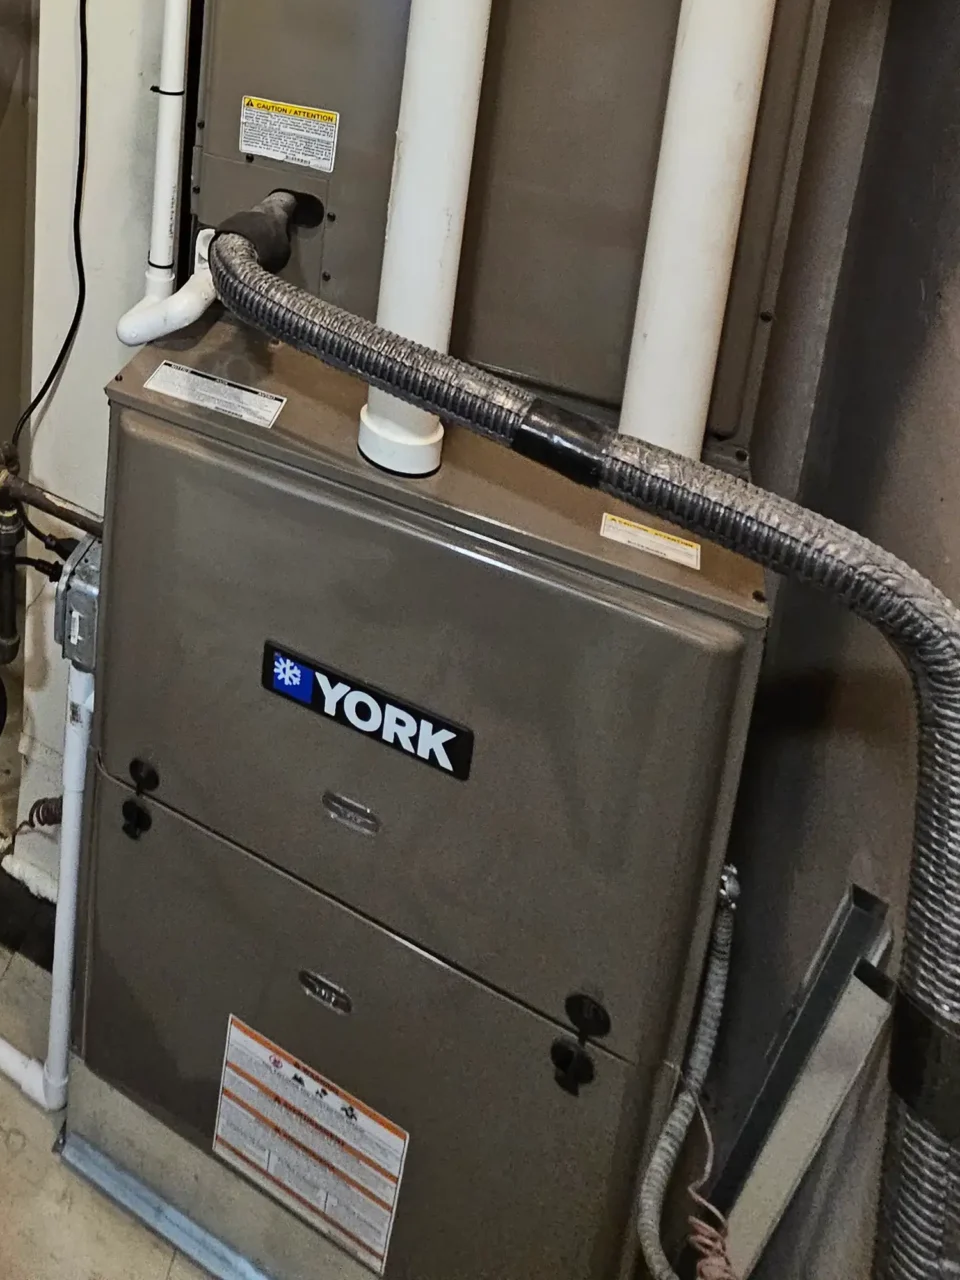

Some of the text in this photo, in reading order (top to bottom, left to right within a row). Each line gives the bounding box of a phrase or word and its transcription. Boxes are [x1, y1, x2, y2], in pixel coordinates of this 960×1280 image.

[256, 103, 287, 114] CAUTION
[293, 110, 334, 122] ATTENTION
[315, 671, 457, 771] YORK
